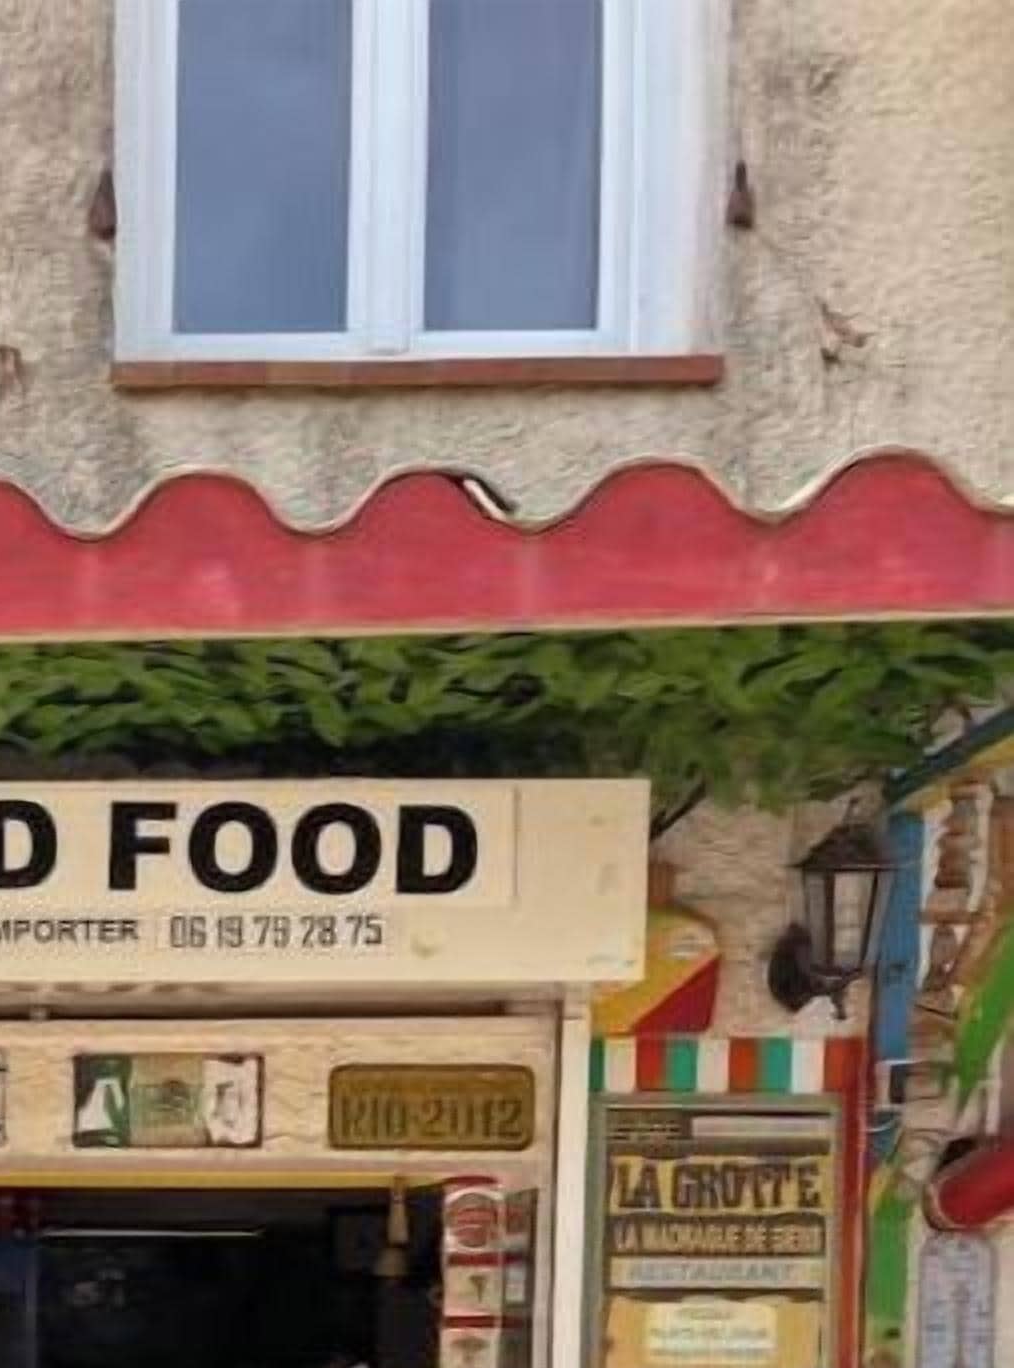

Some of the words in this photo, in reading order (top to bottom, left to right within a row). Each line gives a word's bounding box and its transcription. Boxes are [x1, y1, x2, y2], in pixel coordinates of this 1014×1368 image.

[108, 801, 478, 895] FOOD
[169, 914, 207, 948] 06
[299, 914, 337, 947] 28
[345, 914, 383, 946] 75
[617, 1162, 662, 1209] LA
[670, 1160, 822, 1209] GROTTE
